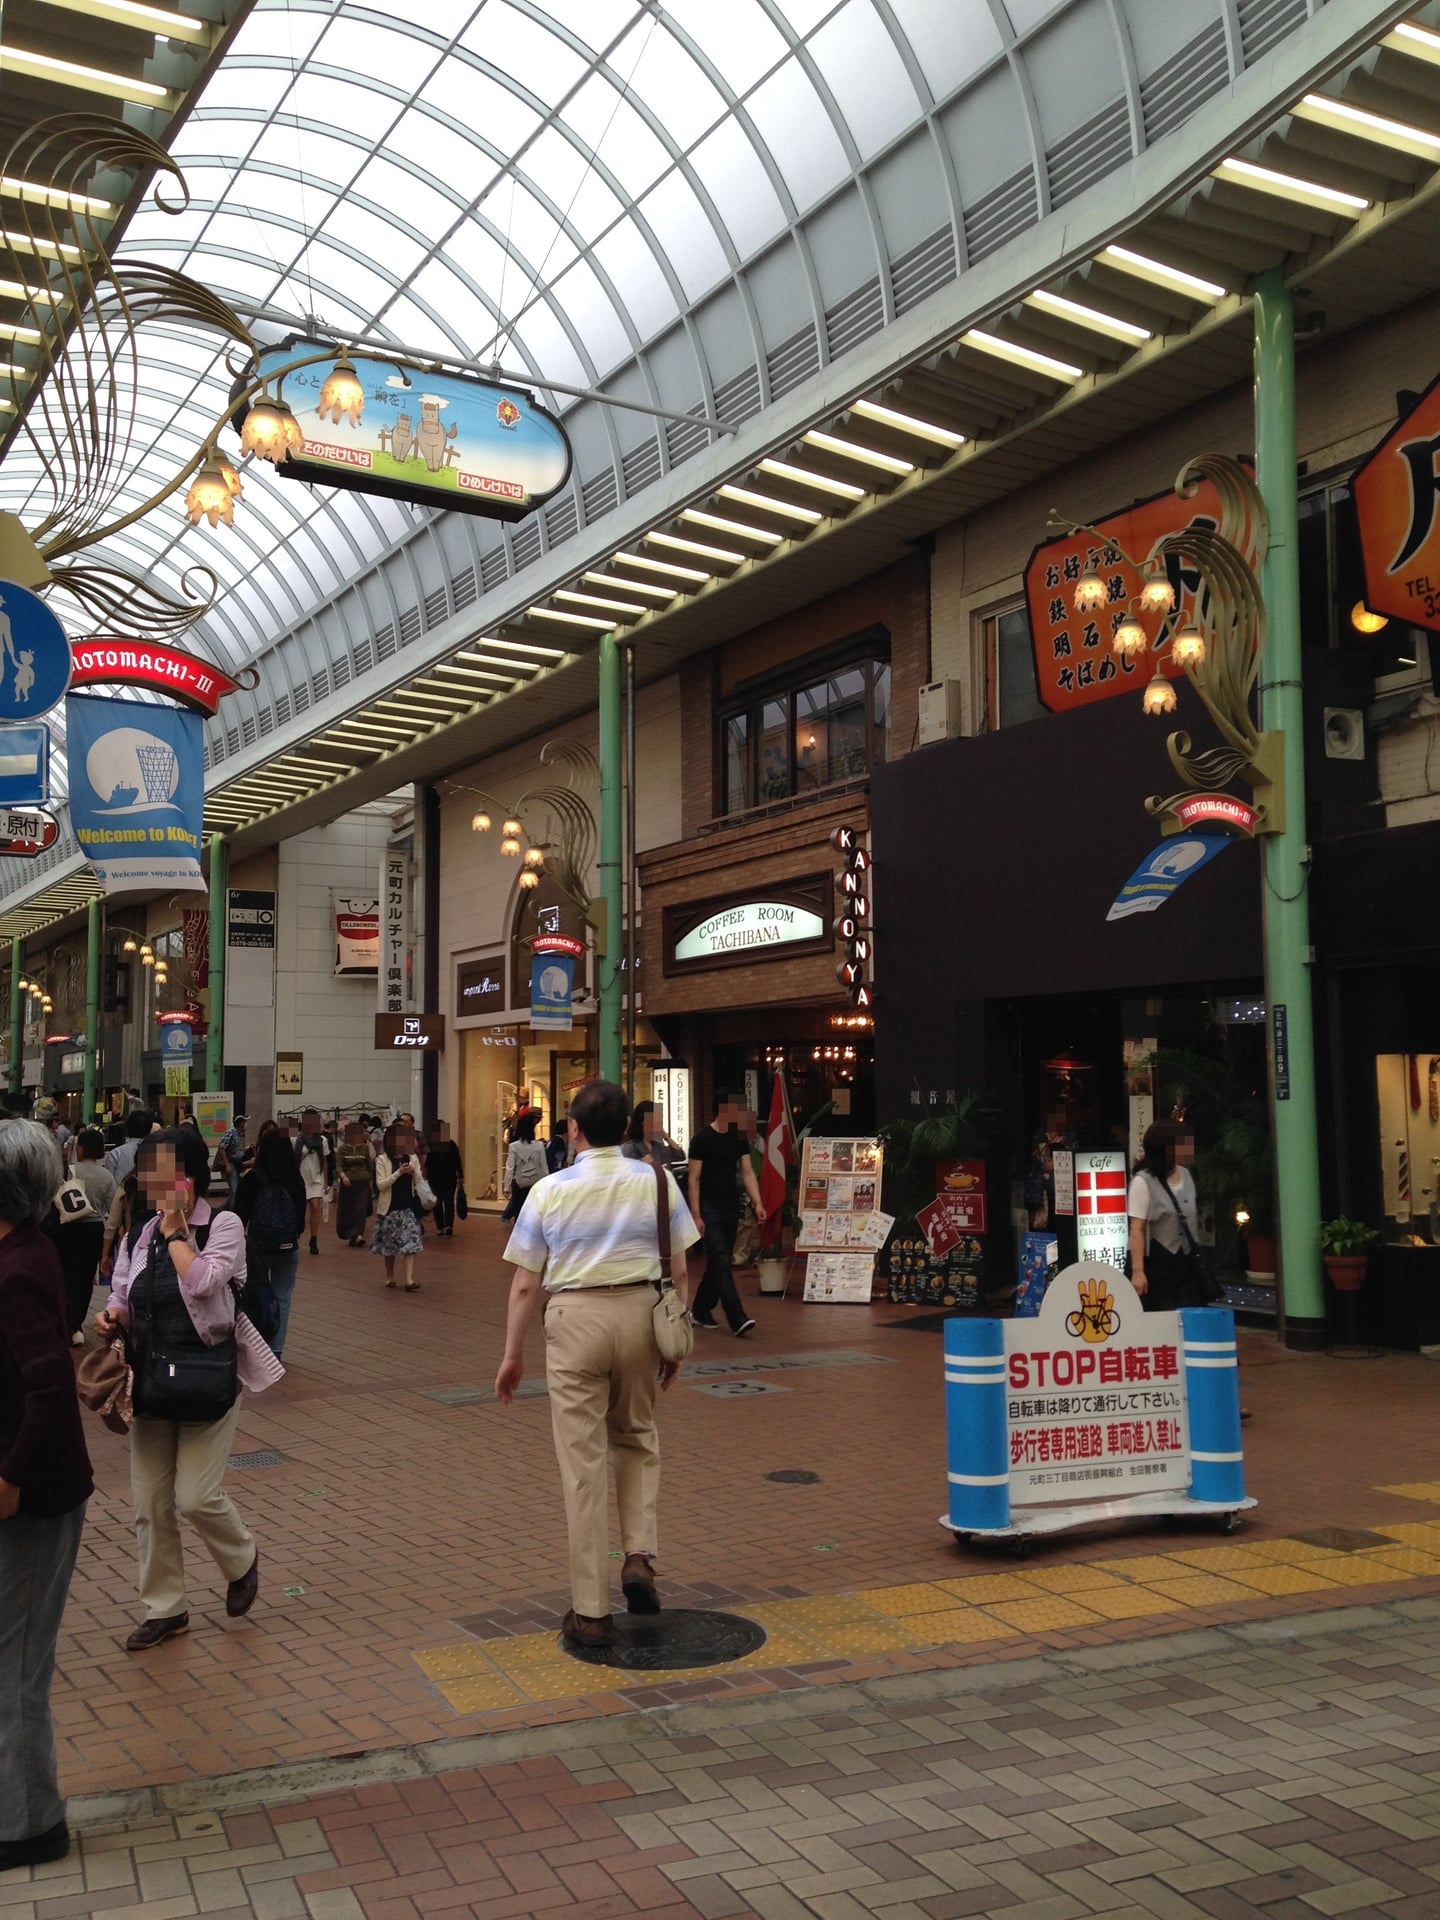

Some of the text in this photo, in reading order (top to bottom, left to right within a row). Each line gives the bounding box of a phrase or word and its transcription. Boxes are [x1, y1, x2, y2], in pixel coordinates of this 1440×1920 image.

[459, 473, 522, 498] ひめじけいば
[1405, 576, 1436, 599] TEL
[1048, 576, 1127, 625] 鉄焼
[77, 828, 147, 845] Welcome
[149, 827, 165, 842] to
[111, 870, 148, 879] Welcome
[150, 868, 179, 880] voyage
[181, 868, 187, 878] to
[698, 907, 795, 939] COFFEE ROOM
[840, 829, 871, 1006] KANNONYA
[387, 860, 404, 1013] 元町カルチャー倶楽部
[710, 925, 781, 950] TACHIBANA
[393, 1035, 430, 1045] ロッサ
[676, 1072, 684, 1121] COFFEE
[1089, 1155, 1112, 1170] Café
[61, 1189, 86, 1213] C
[1080, 1227, 1098, 1236] CAKE
[1009, 1345, 1179, 1389] STOP自転車
[1009, 1392, 1180, 1418] 自転車は降りて通行して下さい。
[1010, 1418, 1182, 1464] 歩行者専用道路 車両進入禁止
